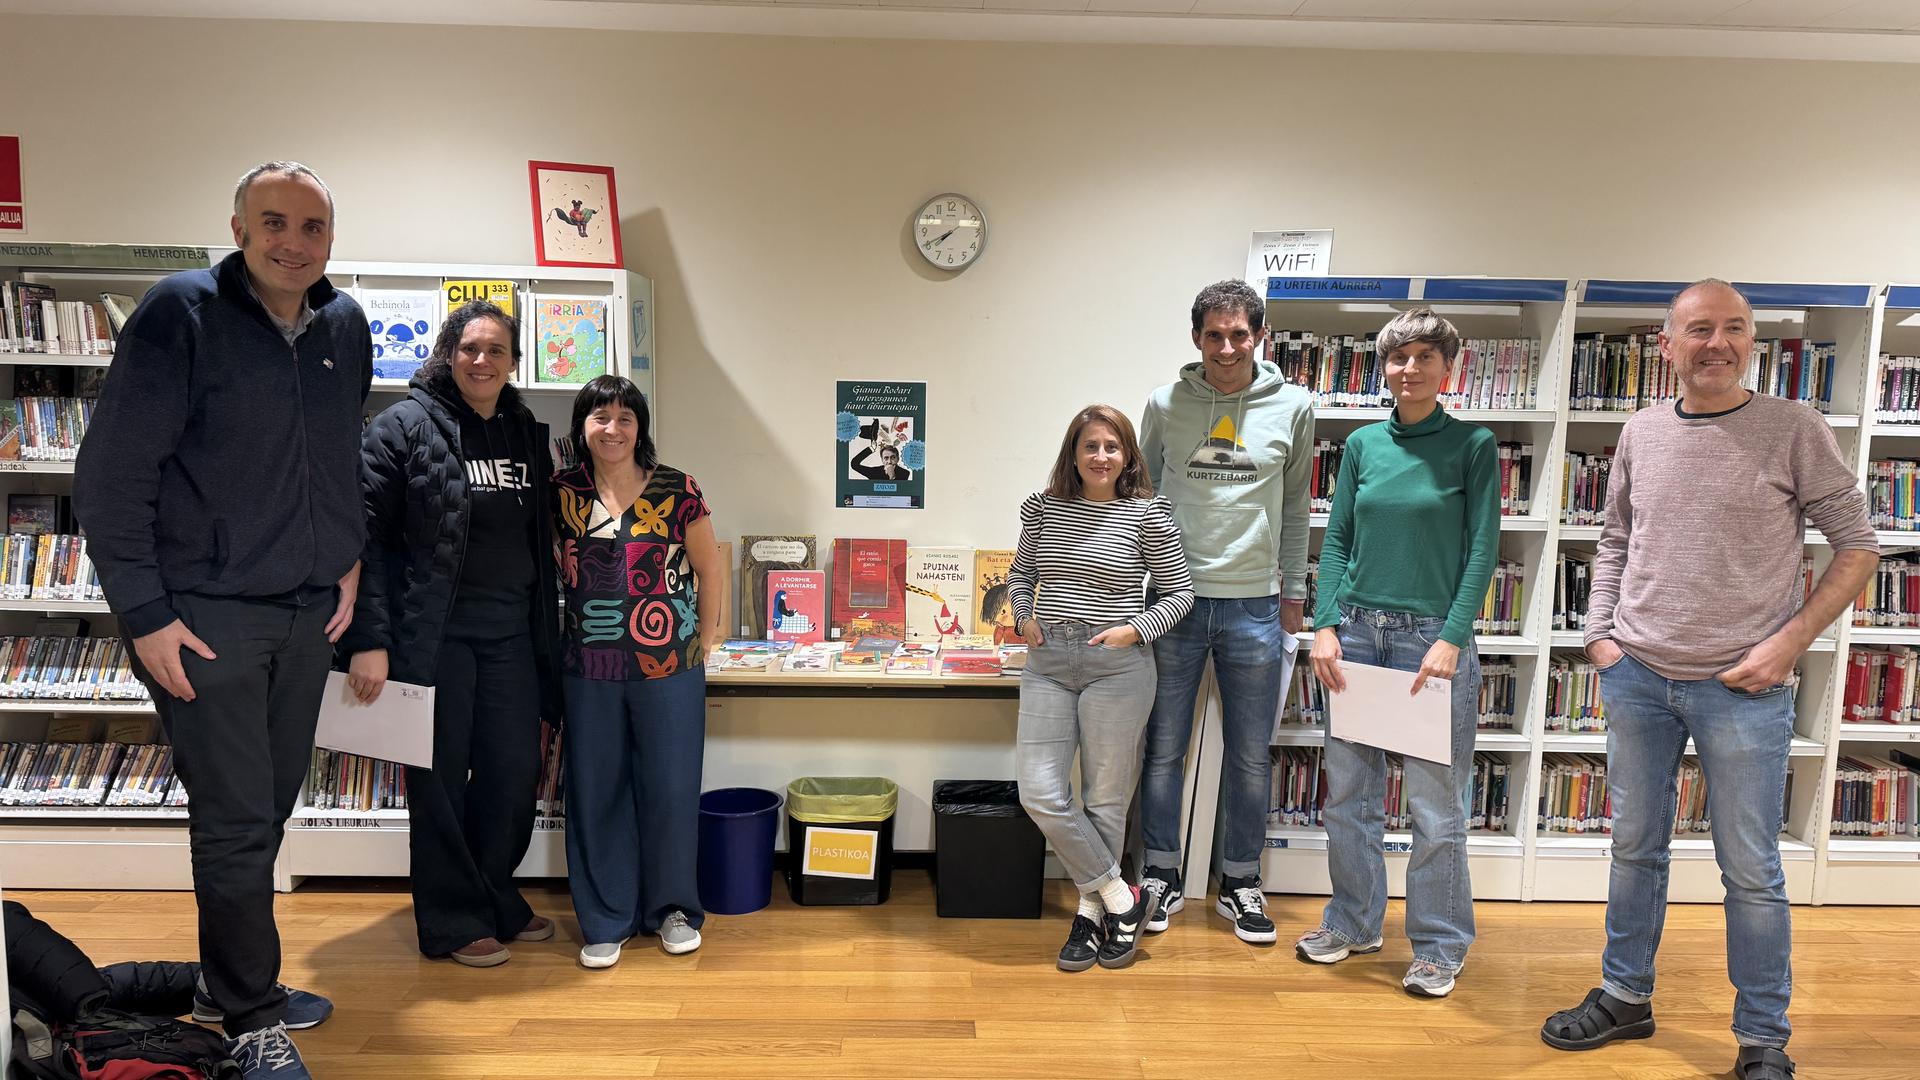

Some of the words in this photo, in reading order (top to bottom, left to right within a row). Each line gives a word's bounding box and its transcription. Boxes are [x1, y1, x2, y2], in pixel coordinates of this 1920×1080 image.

[936, 204, 942, 215] 11
[947, 201, 956, 212] 12
[963, 204, 967, 215] 1
[921, 227, 928, 237] 9
[970, 242, 977, 252] 4
[133, 248, 209, 260] HEMEROTEKA
[935, 250, 941, 260] 7
[947, 254, 954, 264] 6
[961, 251, 967, 262] 5
[1263, 253, 1316, 271] WiFi
[1269, 281, 1281, 290] 12
[1284, 281, 1329, 290] URTETIK
[1330, 281, 1382, 291] AURRERA
[370, 300, 410, 309] Behinola
[852, 385, 881, 395] Gianni
[883, 385, 912, 394] Rodari
[856, 395, 908, 403] interesgunea
[844, 402, 866, 410] haur
[867, 402, 918, 413] liburutegian
[1187, 471, 1257, 482] KURTZEBARRI
[923, 562, 959, 571] IPUINAK
[812, 847, 869, 860] PLASTIKOA
